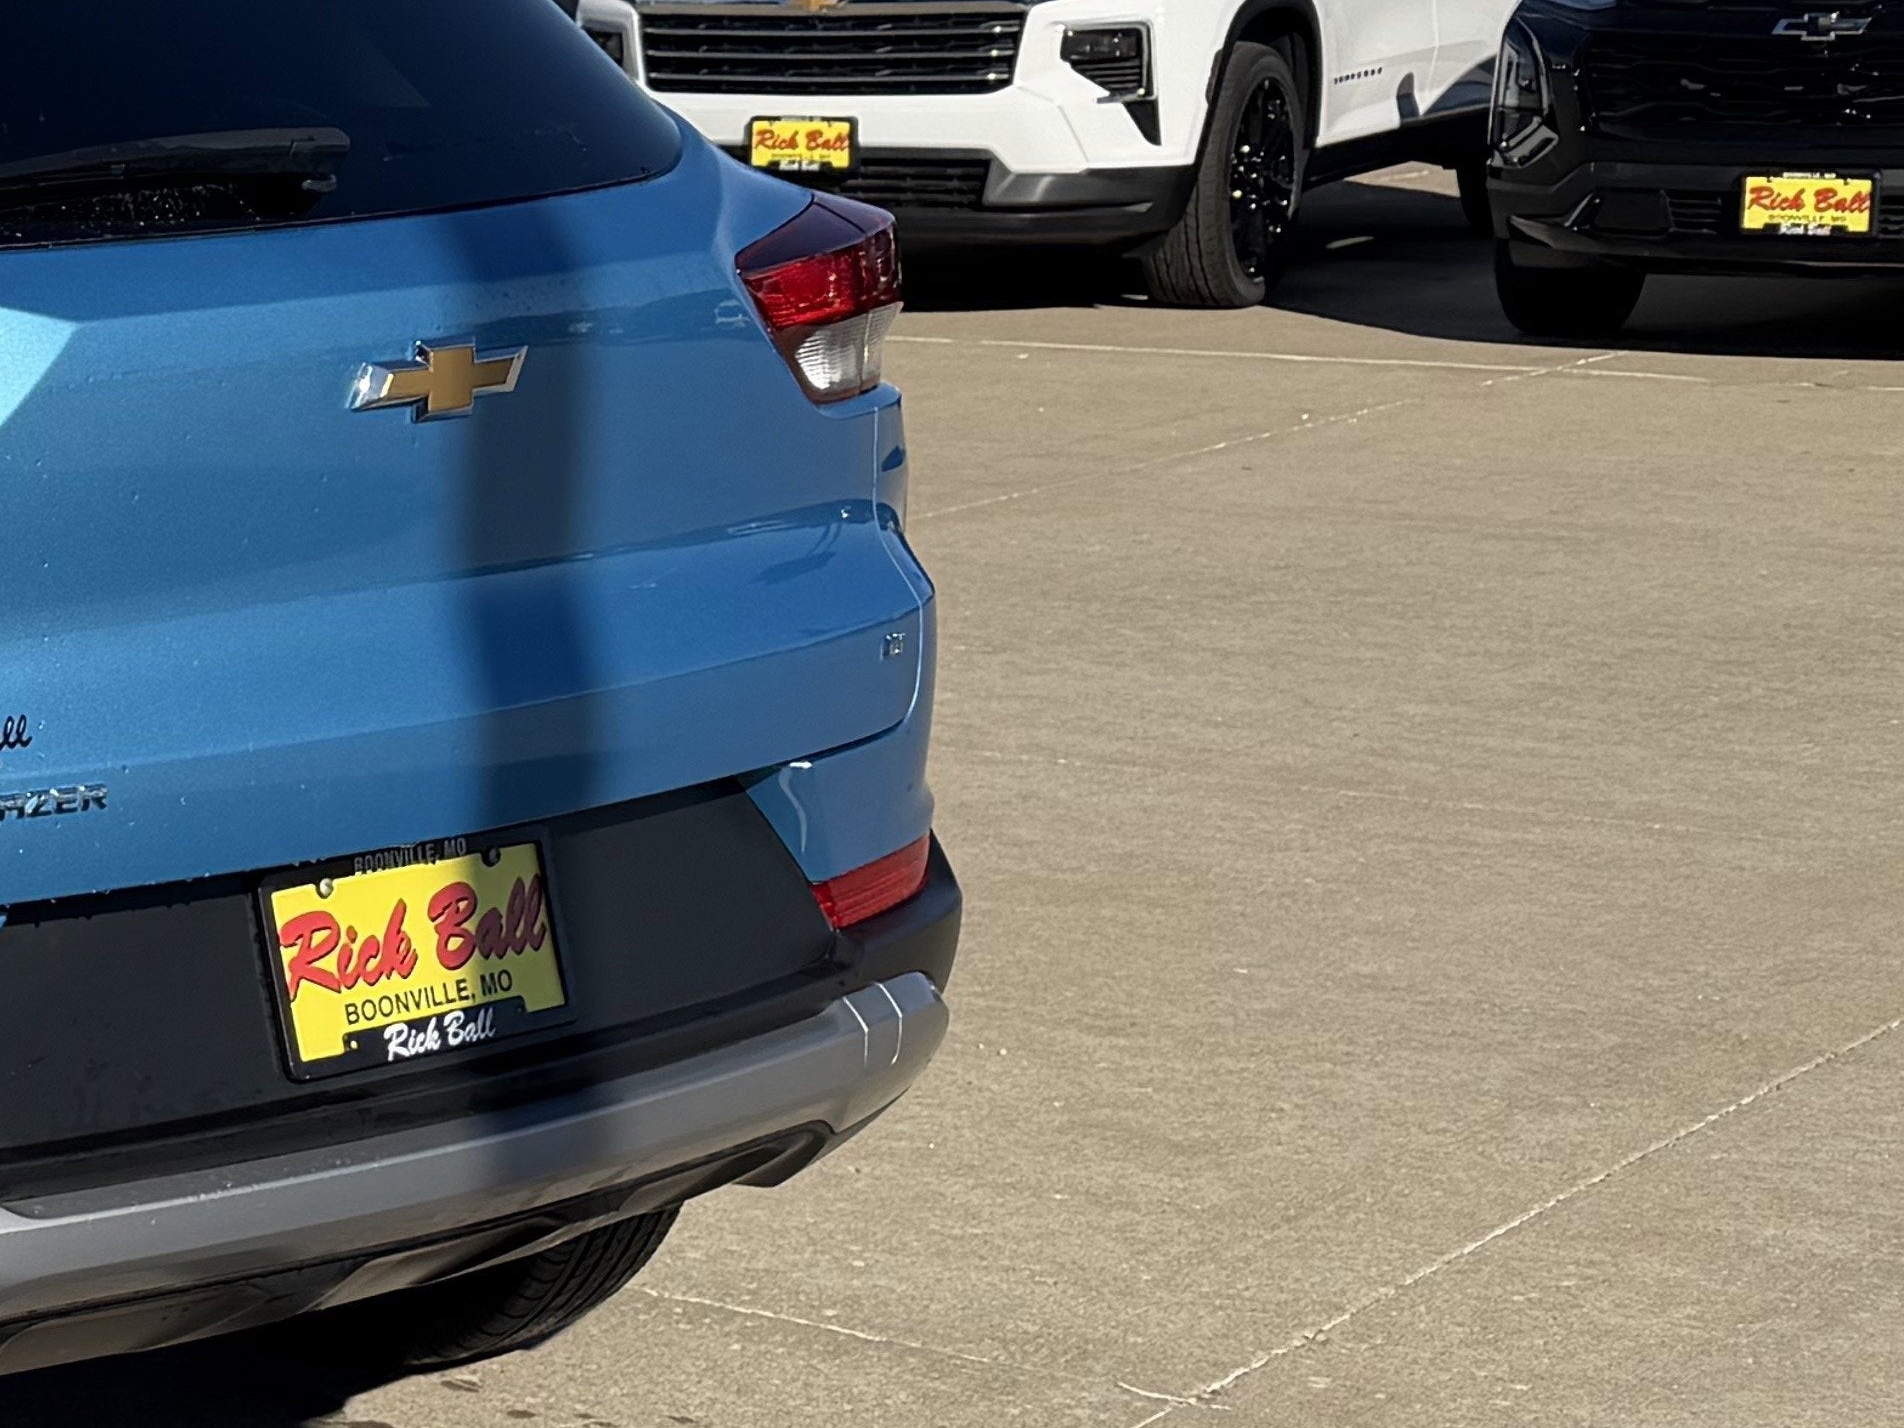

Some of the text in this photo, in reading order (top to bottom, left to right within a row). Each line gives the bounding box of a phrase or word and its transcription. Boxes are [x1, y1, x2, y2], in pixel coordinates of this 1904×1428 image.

[754, 128, 800, 151] Rick
[1747, 185, 1871, 214] Rick Ball
[444, 837, 467, 858] MO
[279, 873, 547, 1003] Rick Ball
[343, 969, 513, 1026] BOONVILLE, MO
[383, 1008, 497, 1063] Rick Ball
